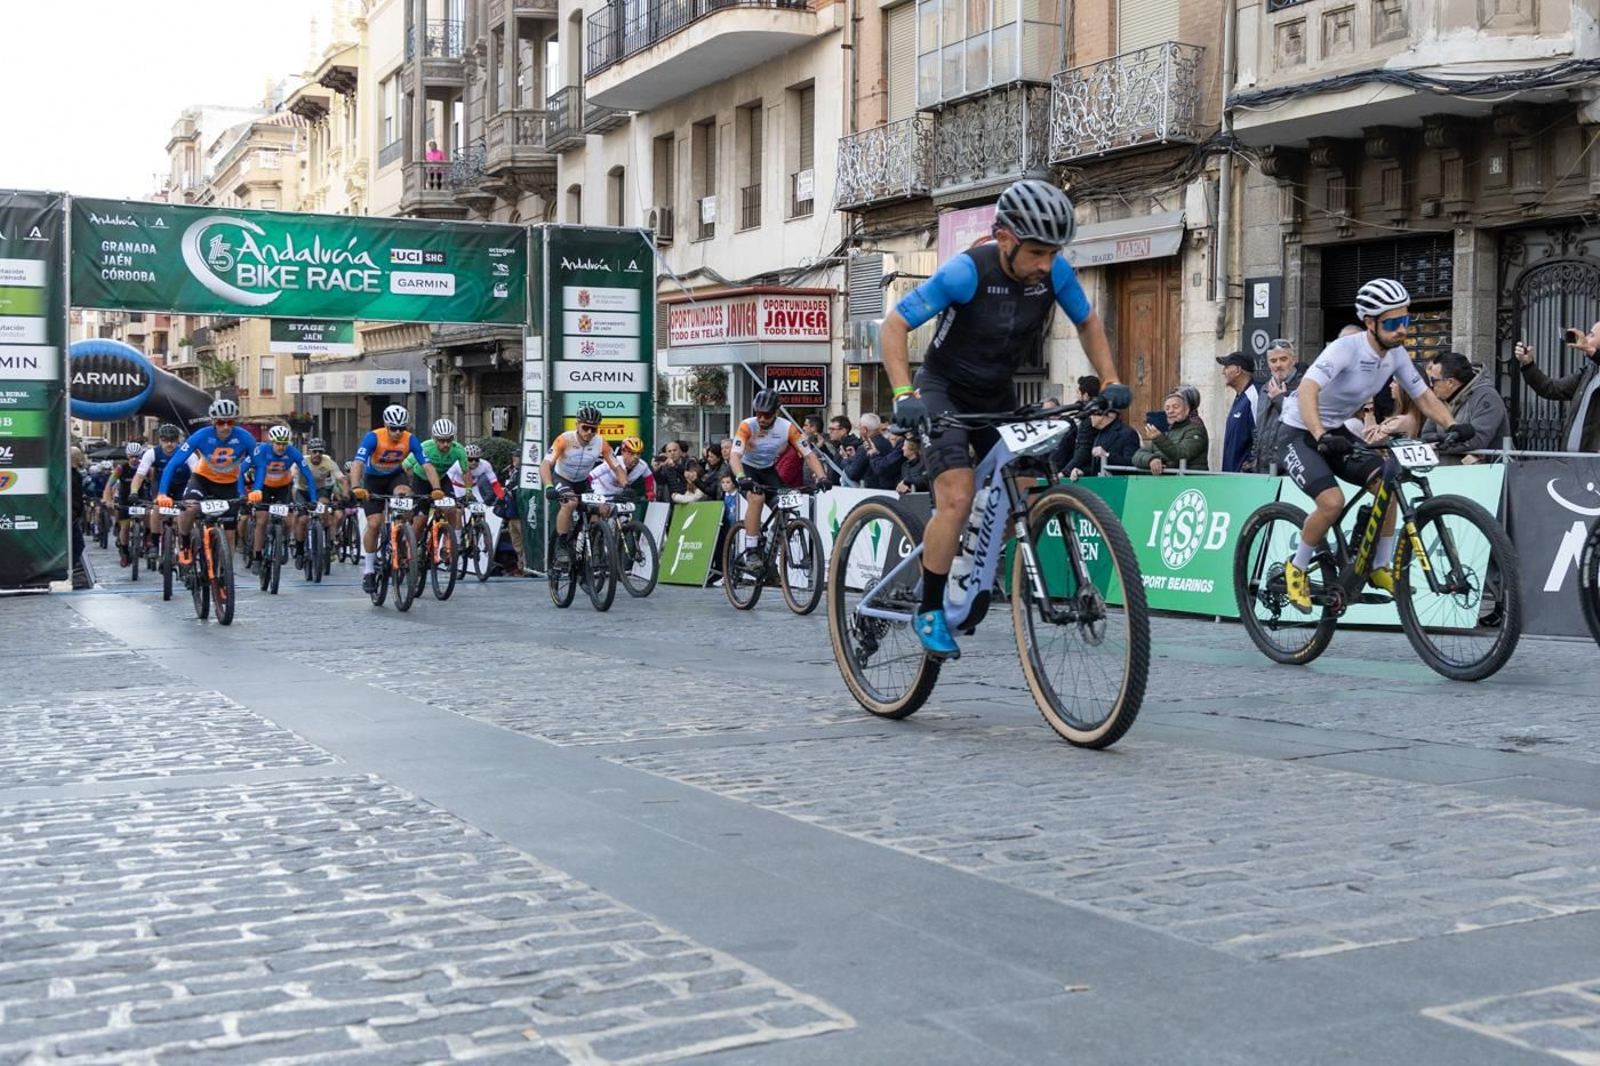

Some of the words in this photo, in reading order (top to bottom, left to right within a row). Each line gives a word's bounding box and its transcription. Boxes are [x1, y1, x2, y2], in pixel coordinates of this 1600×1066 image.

[1492, 158, 1499, 173] 8
[102, 240, 157, 255] GRANADA
[236, 229, 380, 270] Andalucía
[101, 254, 133, 266] JAÉN
[396, 251, 420, 262] UCI
[560, 257, 612, 272] Andalucía
[101, 268, 156, 282] CÓRDOBA
[237, 263, 299, 290] BIKE
[306, 267, 382, 293] RACE
[397, 279, 448, 289] GARMIN
[763, 300, 828, 311] OPORTUNIDADES
[671, 305, 723, 330] OPORTUNIDADES
[726, 302, 758, 337] JAVIER
[764, 311, 828, 328] JAVIER
[288, 323, 325, 332] STAGE
[671, 331, 689, 340] TODO
[690, 330, 699, 338] EN
[701, 328, 724, 338] TELAS
[764, 327, 787, 336] TODO
[789, 328, 800, 336] EN
[803, 328, 829, 336] TELAS
[72, 372, 141, 386] ARMIN
[376, 377, 400, 385] asisa
[569, 370, 634, 382] GARMIN
[773, 380, 820, 392] JAVIER
[1010, 420, 1058, 442] 54-2
[1402, 446, 1432, 462] 47-2
[781, 495, 798, 506] 52-1
[1353, 480, 1388, 577] SCOTT
[971, 486, 1001, 589] S-WORKS
[1080, 539, 1099, 561] ÉN
[1167, 576, 1215, 593] BEARINGS
